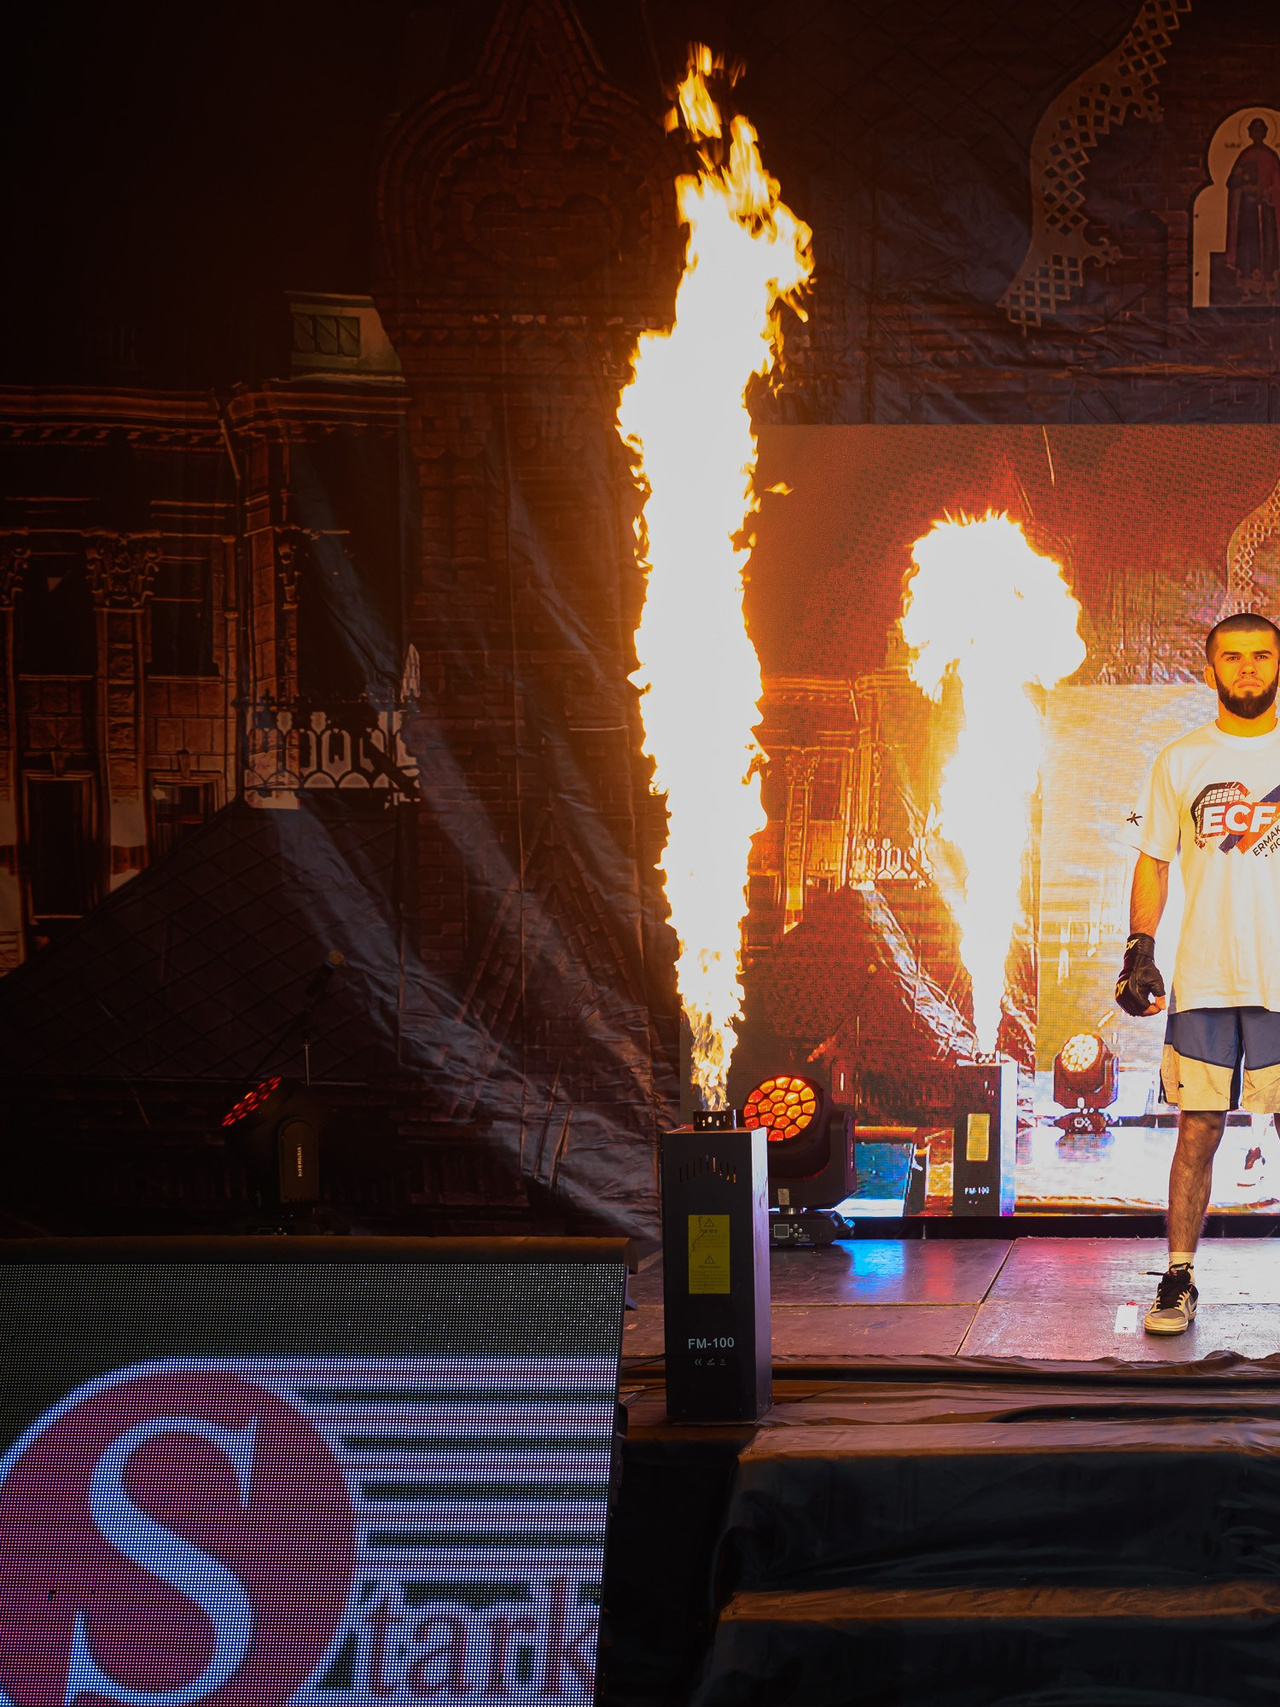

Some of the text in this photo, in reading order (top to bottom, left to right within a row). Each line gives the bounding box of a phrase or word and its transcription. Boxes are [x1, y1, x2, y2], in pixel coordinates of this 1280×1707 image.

[1202, 804, 1277, 834] ECF
[1252, 825, 1280, 856] ERMAK
[688, 1337, 735, 1349] FM-100
